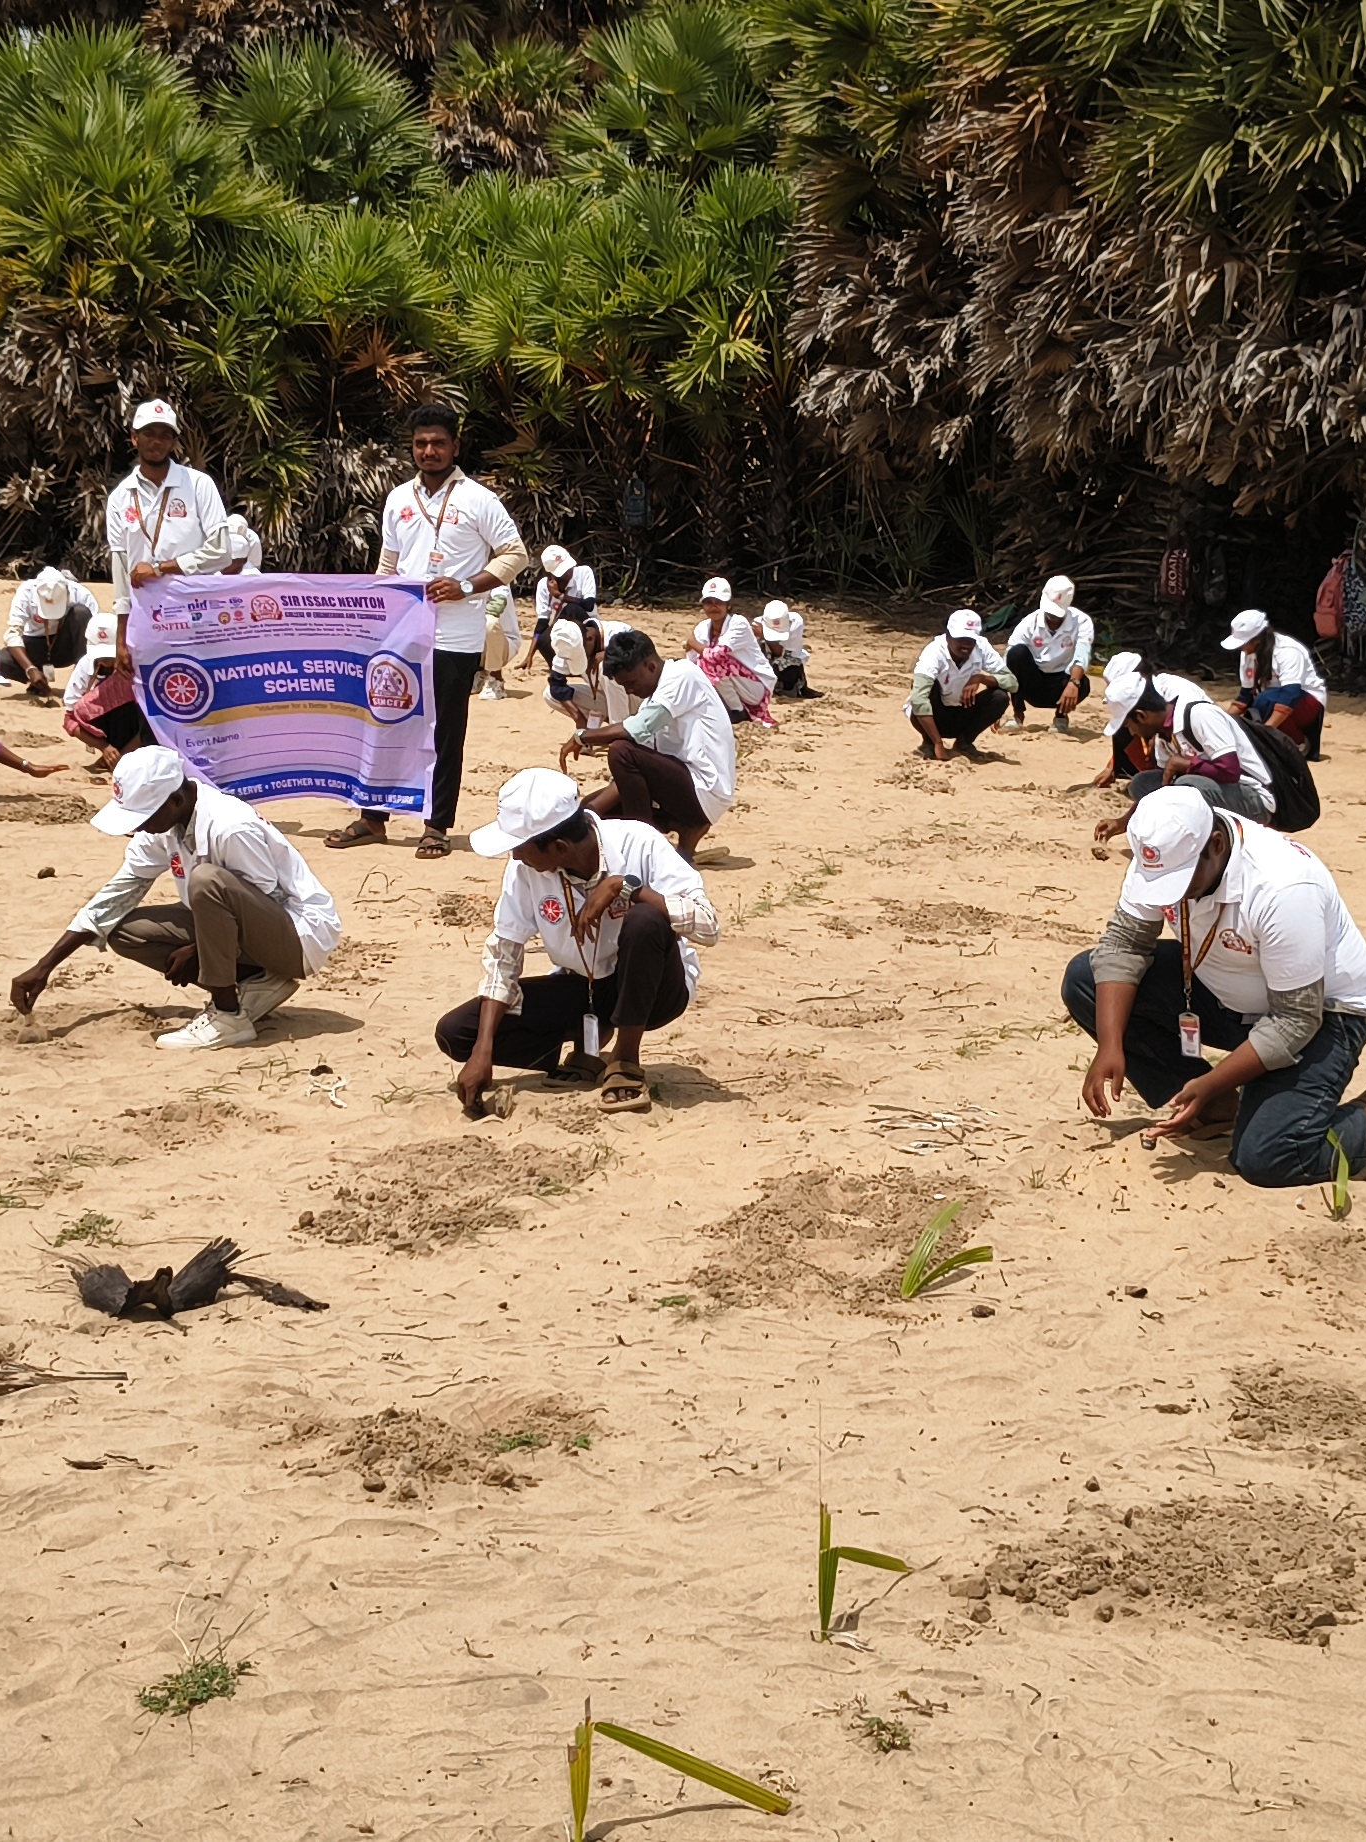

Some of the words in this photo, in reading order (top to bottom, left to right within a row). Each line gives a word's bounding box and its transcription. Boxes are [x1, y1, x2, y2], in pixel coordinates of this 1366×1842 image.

[280, 595, 301, 607] SIR
[303, 595, 336, 607] ISSAC
[337, 596, 385, 609] NEWTON
[213, 661, 298, 682] NATIONAL
[302, 660, 364, 679] SERVICE
[264, 678, 335, 694] SCHEME
[185, 738, 211, 748] Event
[212, 733, 240, 744] Name
[237, 784, 263, 796] SERVE
[270, 777, 314, 790] TOGETHER
[315, 778, 326, 787] WE
